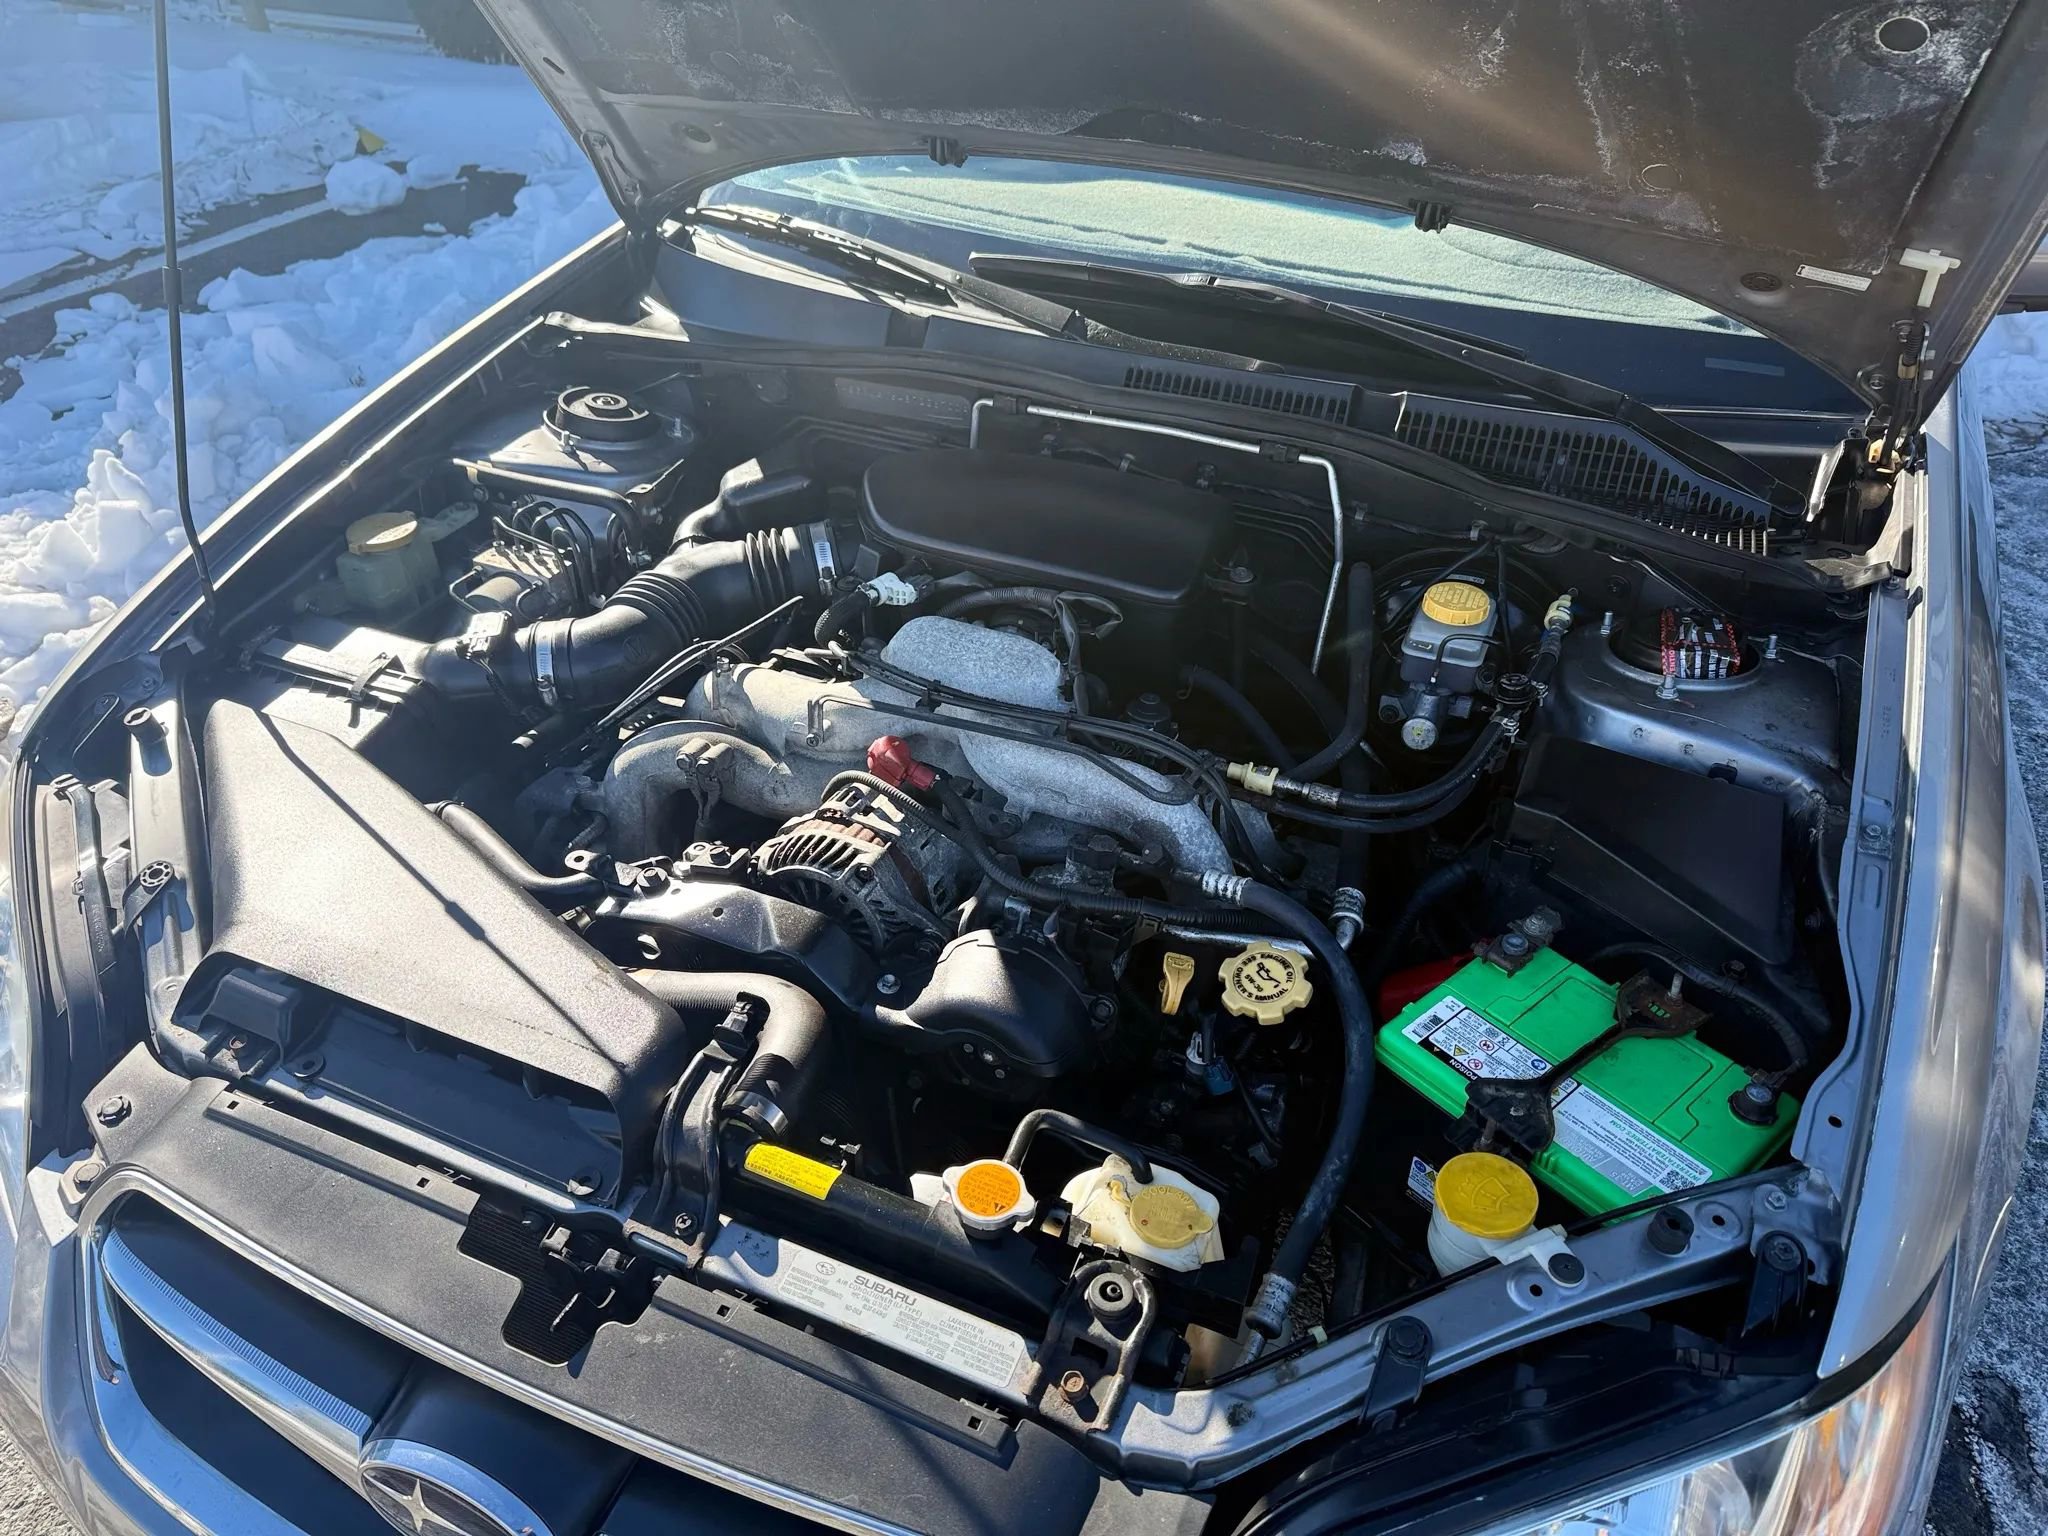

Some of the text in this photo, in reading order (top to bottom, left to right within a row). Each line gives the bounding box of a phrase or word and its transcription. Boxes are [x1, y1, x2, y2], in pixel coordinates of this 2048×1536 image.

[1260, 953, 1294, 983] ENGINE OIL
[1254, 987, 1289, 1001] MANUAL
[1448, 1057, 1478, 1080] POISON
[1607, 1118, 1702, 1182] INTERSTATEBATTERIES.COM
[848, 1282, 893, 1305] CONDITIONER
[853, 1273, 917, 1308] SUBARU
[1008, 1340, 1016, 1348] A
